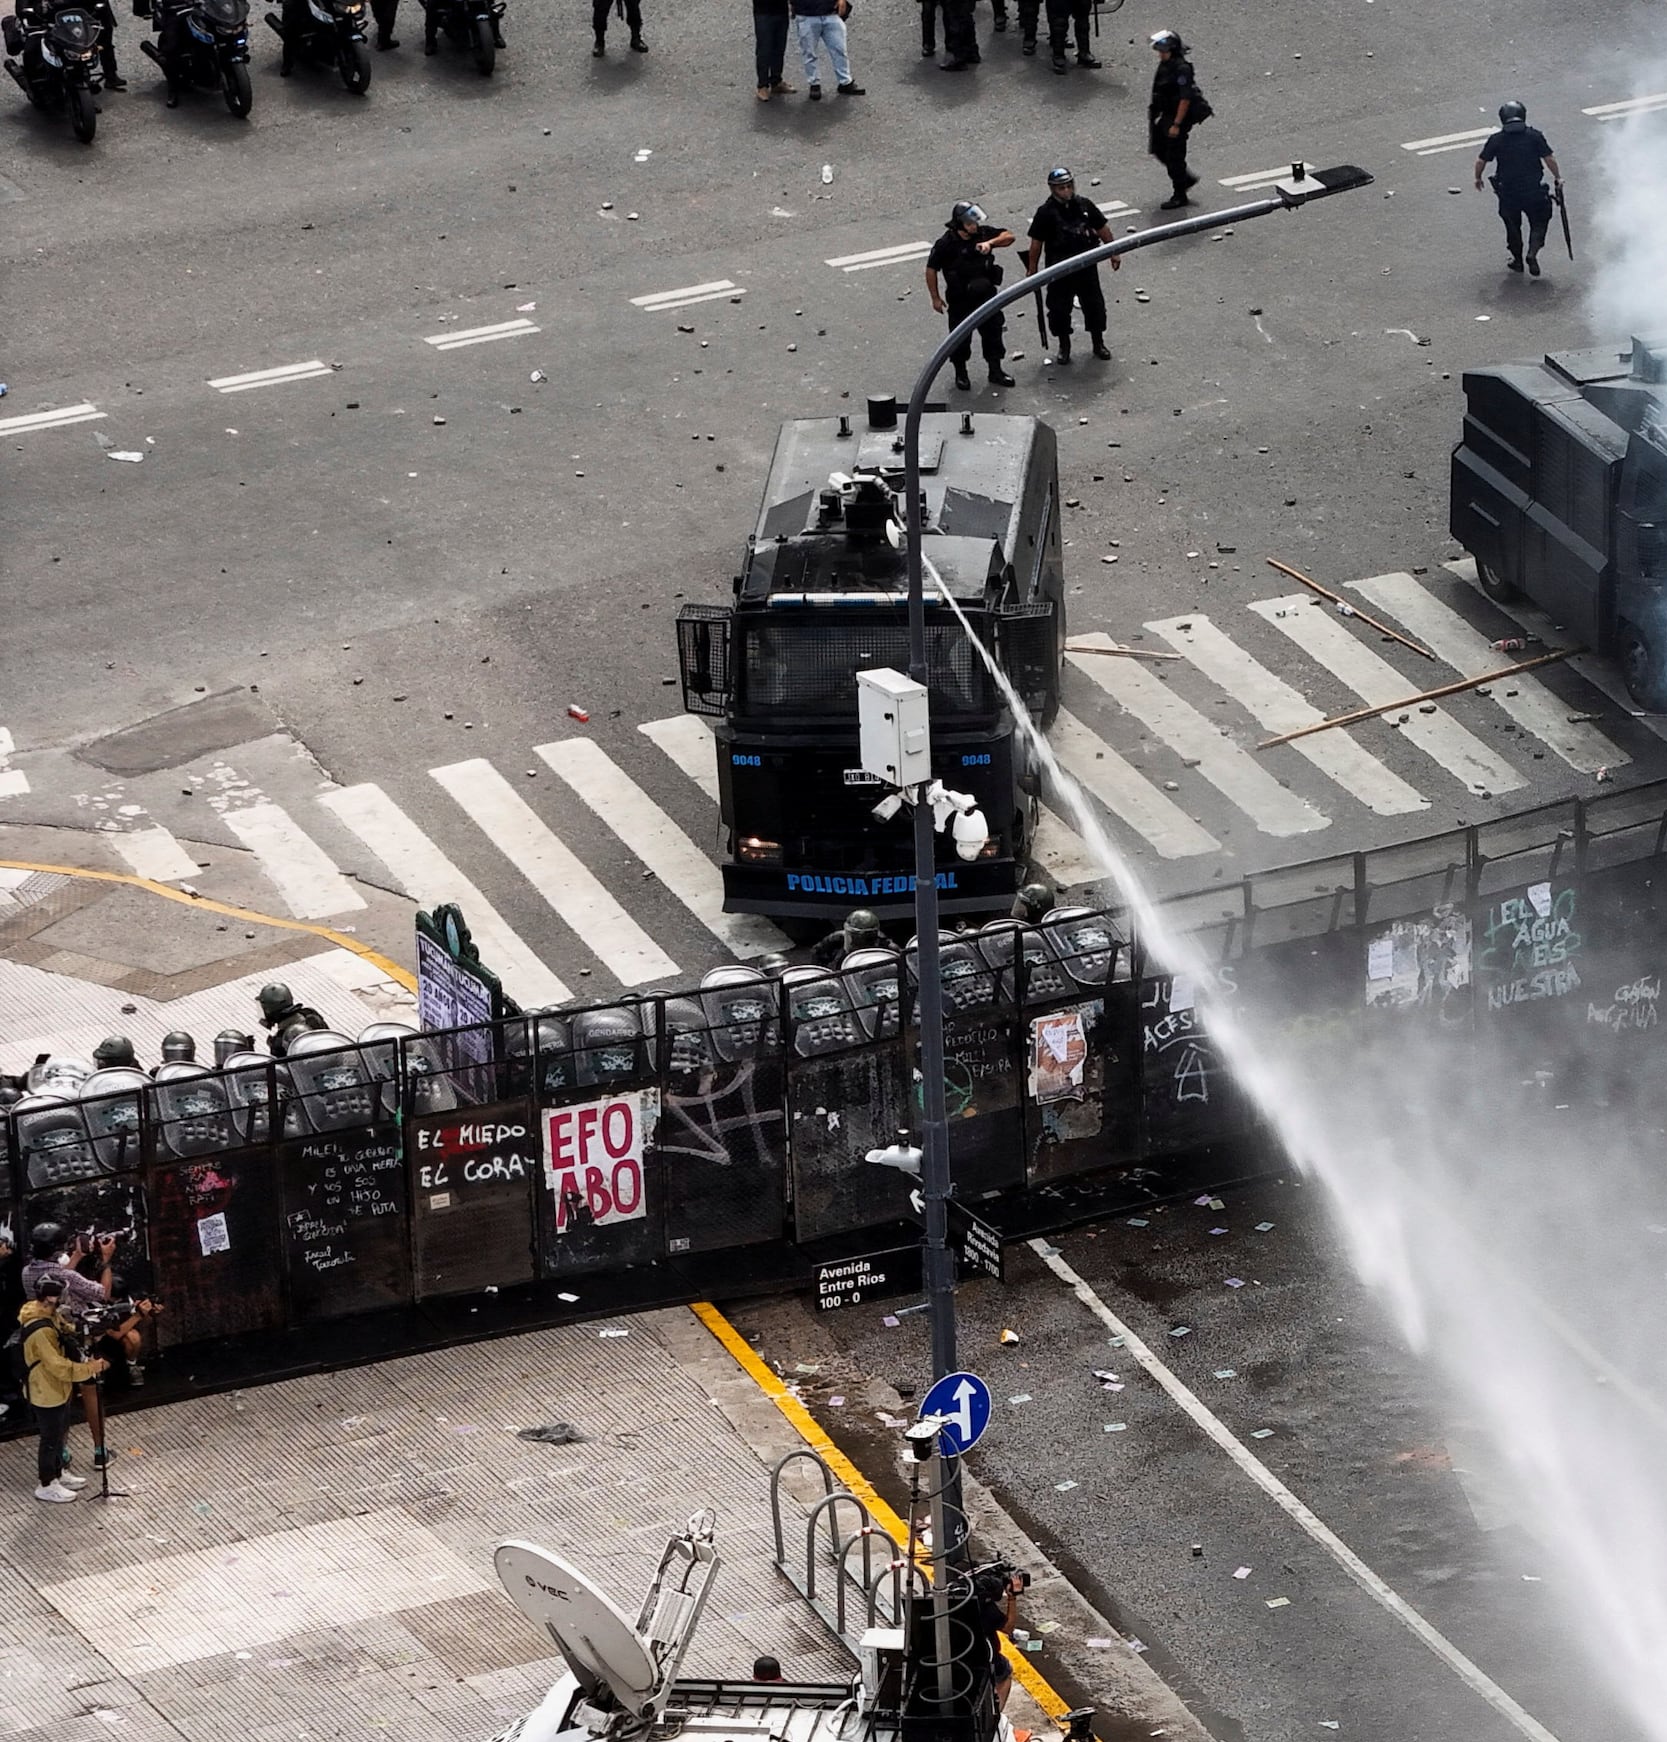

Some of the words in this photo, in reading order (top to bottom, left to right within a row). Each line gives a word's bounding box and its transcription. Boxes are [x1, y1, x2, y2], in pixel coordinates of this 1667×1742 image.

[732, 754, 761, 767] 9048
[961, 753, 991, 767] 9048
[787, 873, 868, 896] POLICIA
[871, 872, 958, 895] FEDEAL
[1512, 916, 1570, 948] AGUA
[418, 1128, 445, 1151] EL
[459, 1124, 526, 1147] MIEDO
[550, 1102, 633, 1171] EFO
[420, 1162, 449, 1188] EL
[556, 1158, 642, 1228] ABO
[819, 1261, 871, 1281] Avenida
[819, 1276, 854, 1296] Entre
[819, 1296, 841, 1310] 100
[852, 1292, 861, 1305] 0
